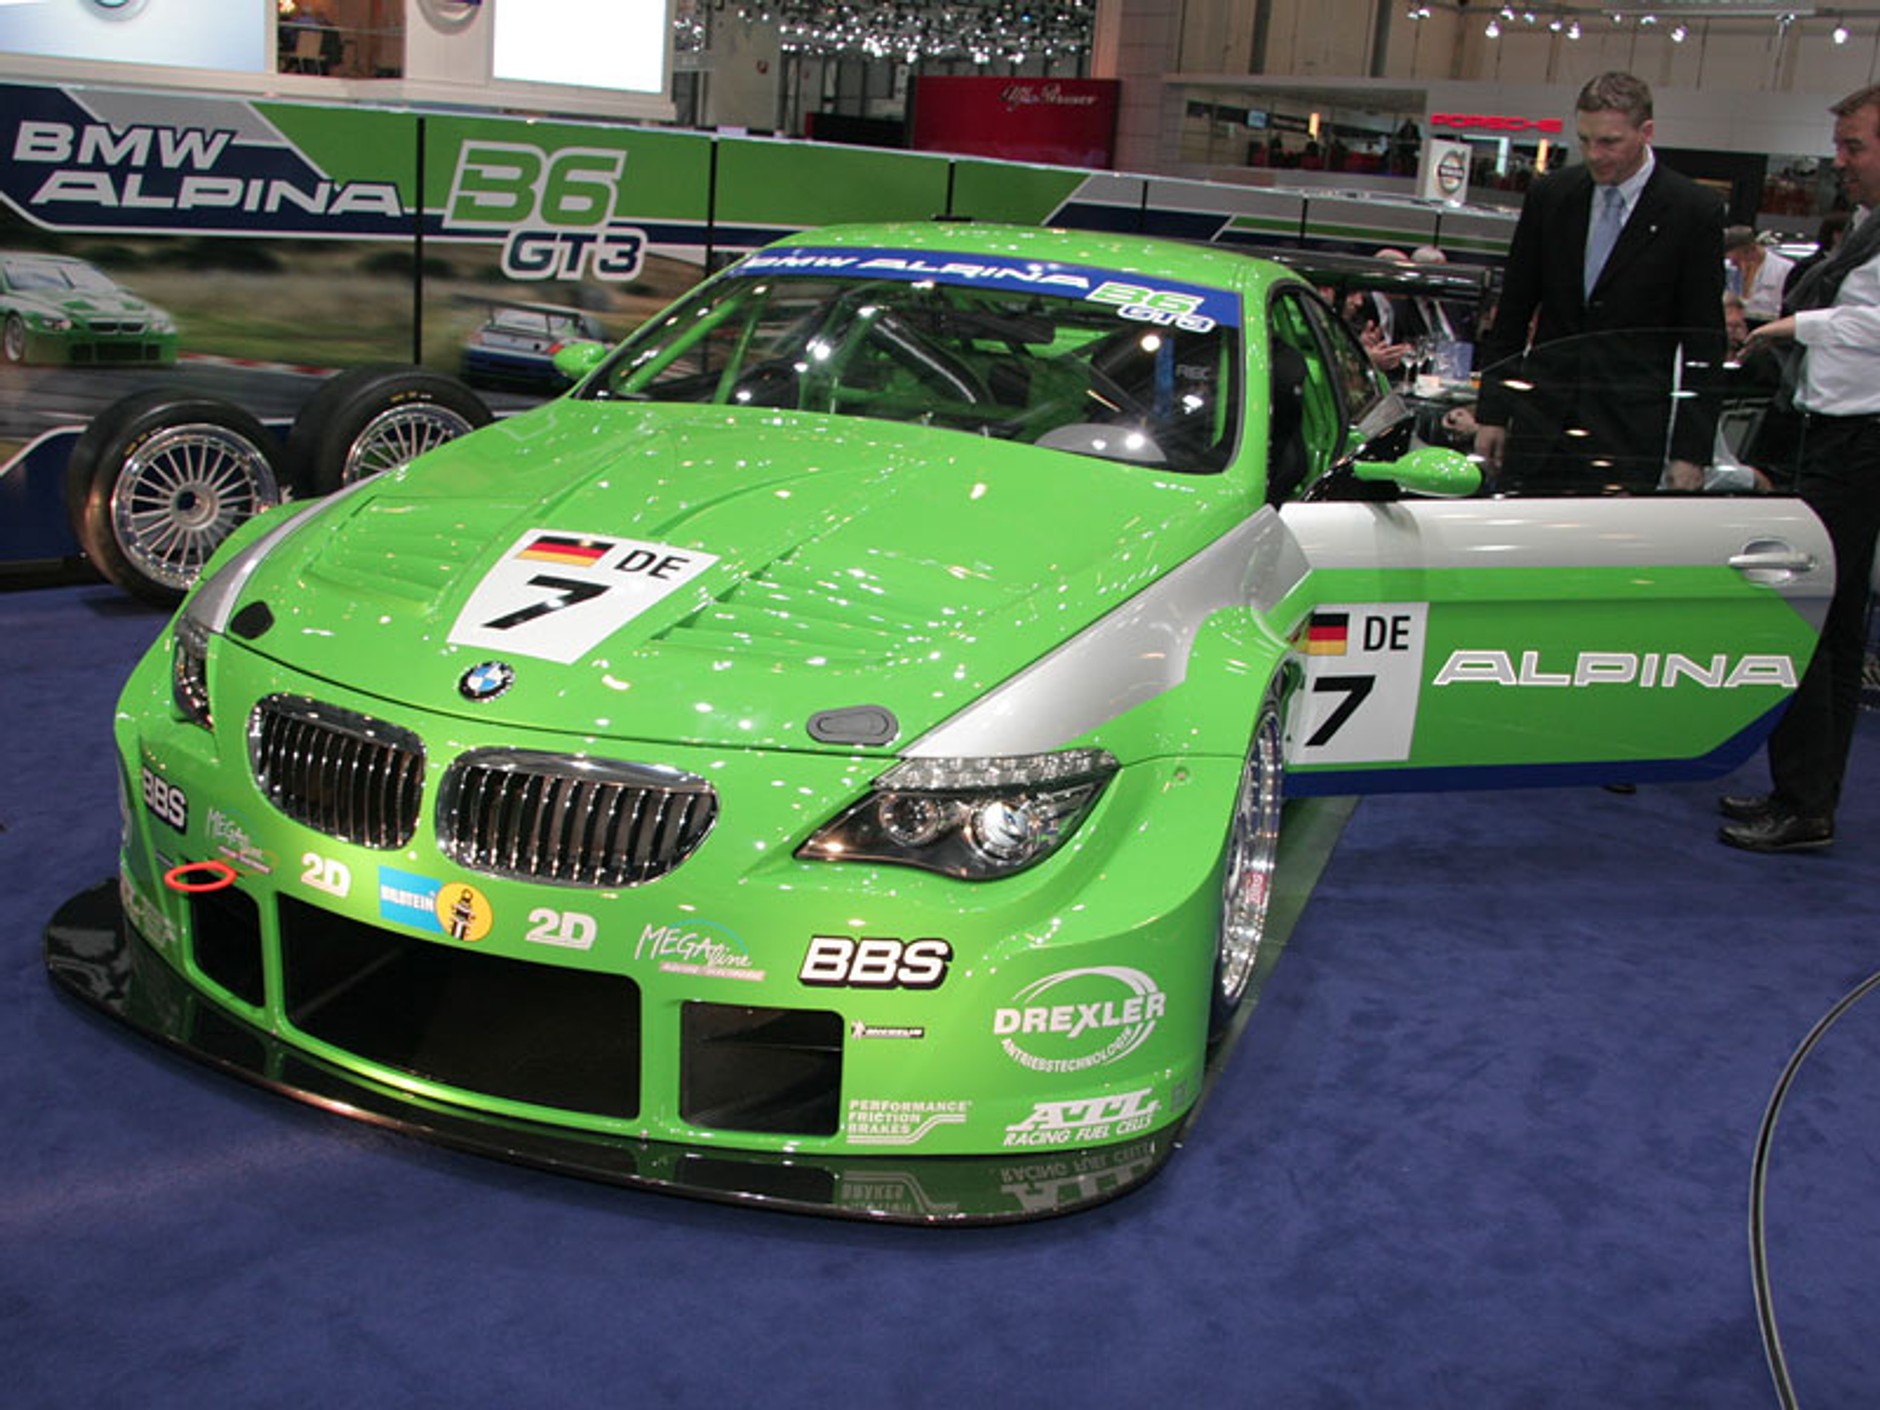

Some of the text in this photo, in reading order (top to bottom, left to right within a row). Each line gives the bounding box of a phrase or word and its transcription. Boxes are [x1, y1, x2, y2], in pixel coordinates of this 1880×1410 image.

[1430, 113, 1563, 132] PORSCHE
[12, 120, 231, 170] BMW
[30, 170, 403, 217] ALPINA
[442, 140, 627, 229] B6
[503, 227, 648, 281] GT3
[742, 256, 1091, 288] BMW ALPINA
[1084, 281, 1205, 314] B6
[1117, 304, 1217, 333] GT3
[614, 550, 691, 580] DE
[481, 574, 612, 630] 7
[1362, 615, 1411, 651] DE
[1431, 650, 1799, 688] ALPINA
[1304, 674, 1377, 747] 7
[143, 768, 187, 830] BBS
[301, 852, 351, 898] 2D
[525, 907, 597, 951] 2D
[799, 935, 952, 989] BBS
[993, 992, 1167, 1039] DREXLER
[848, 1099, 967, 1112] PERFORMANCE
[1005, 1088, 1162, 1133] ATL
[847, 1122, 911, 1134] BRAKES
[1003, 1128, 1071, 1146] RACING
[1075, 1124, 1111, 1141] FUEL
